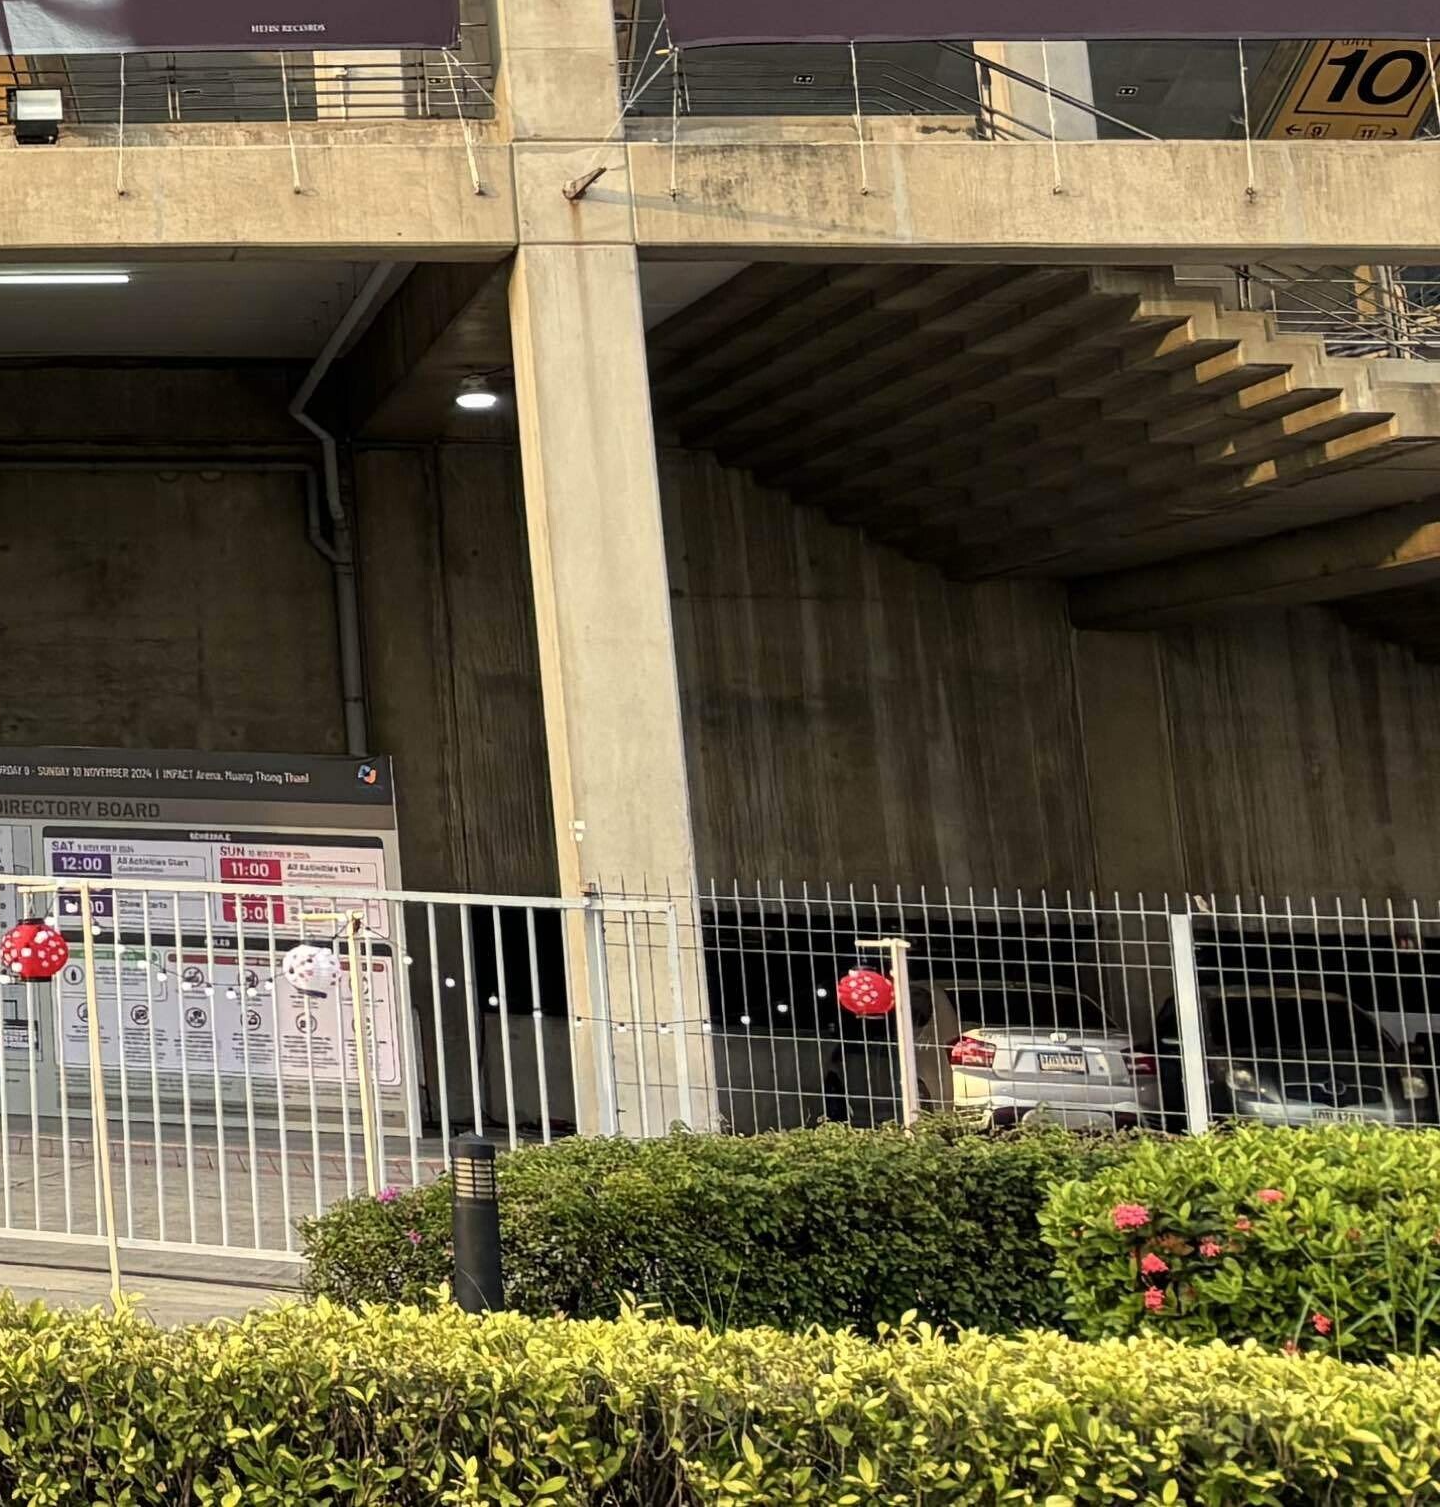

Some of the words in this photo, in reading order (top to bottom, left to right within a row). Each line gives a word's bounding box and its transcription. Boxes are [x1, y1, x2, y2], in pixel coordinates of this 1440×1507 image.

[1327, 49, 1427, 105] 10
[37, 766, 70, 777] SUNDAY
[83, 766, 129, 778] NOVEMBER
[131, 767, 152, 779] 2024
[162, 768, 193, 780] IMPACT
[255, 771, 282, 784] Thong
[97, 801, 161, 819] BOARD
[52, 841, 73, 852] SAT
[220, 846, 245, 857] SUN
[61, 856, 102, 871] 12:00
[232, 862, 269, 877] 11:00
